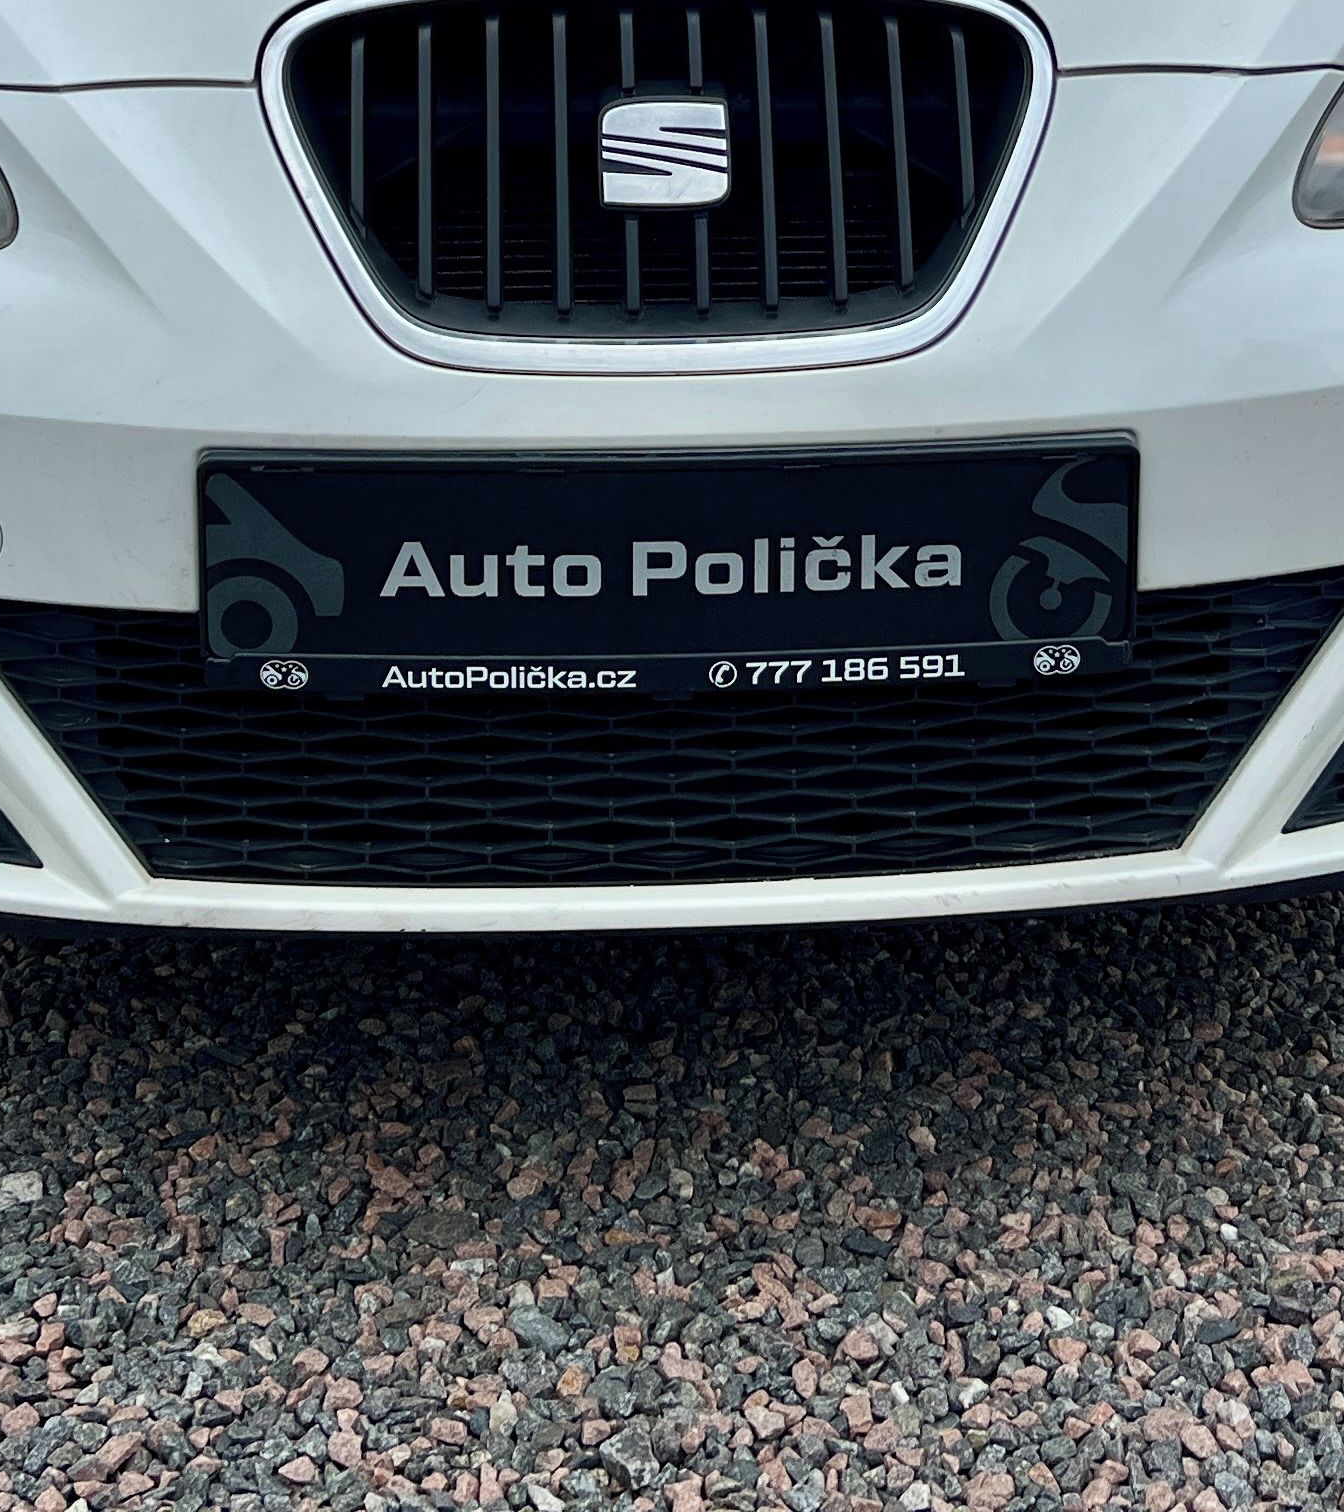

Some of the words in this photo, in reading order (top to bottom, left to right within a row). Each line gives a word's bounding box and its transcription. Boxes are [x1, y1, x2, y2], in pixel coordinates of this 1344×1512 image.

[379, 541, 602, 598] Auto
[632, 534, 962, 597] Polička
[382, 665, 637, 689] AutoPolička.cz
[745, 660, 812, 685] 777
[821, 657, 889, 683] 186
[899, 653, 966, 679] 591
